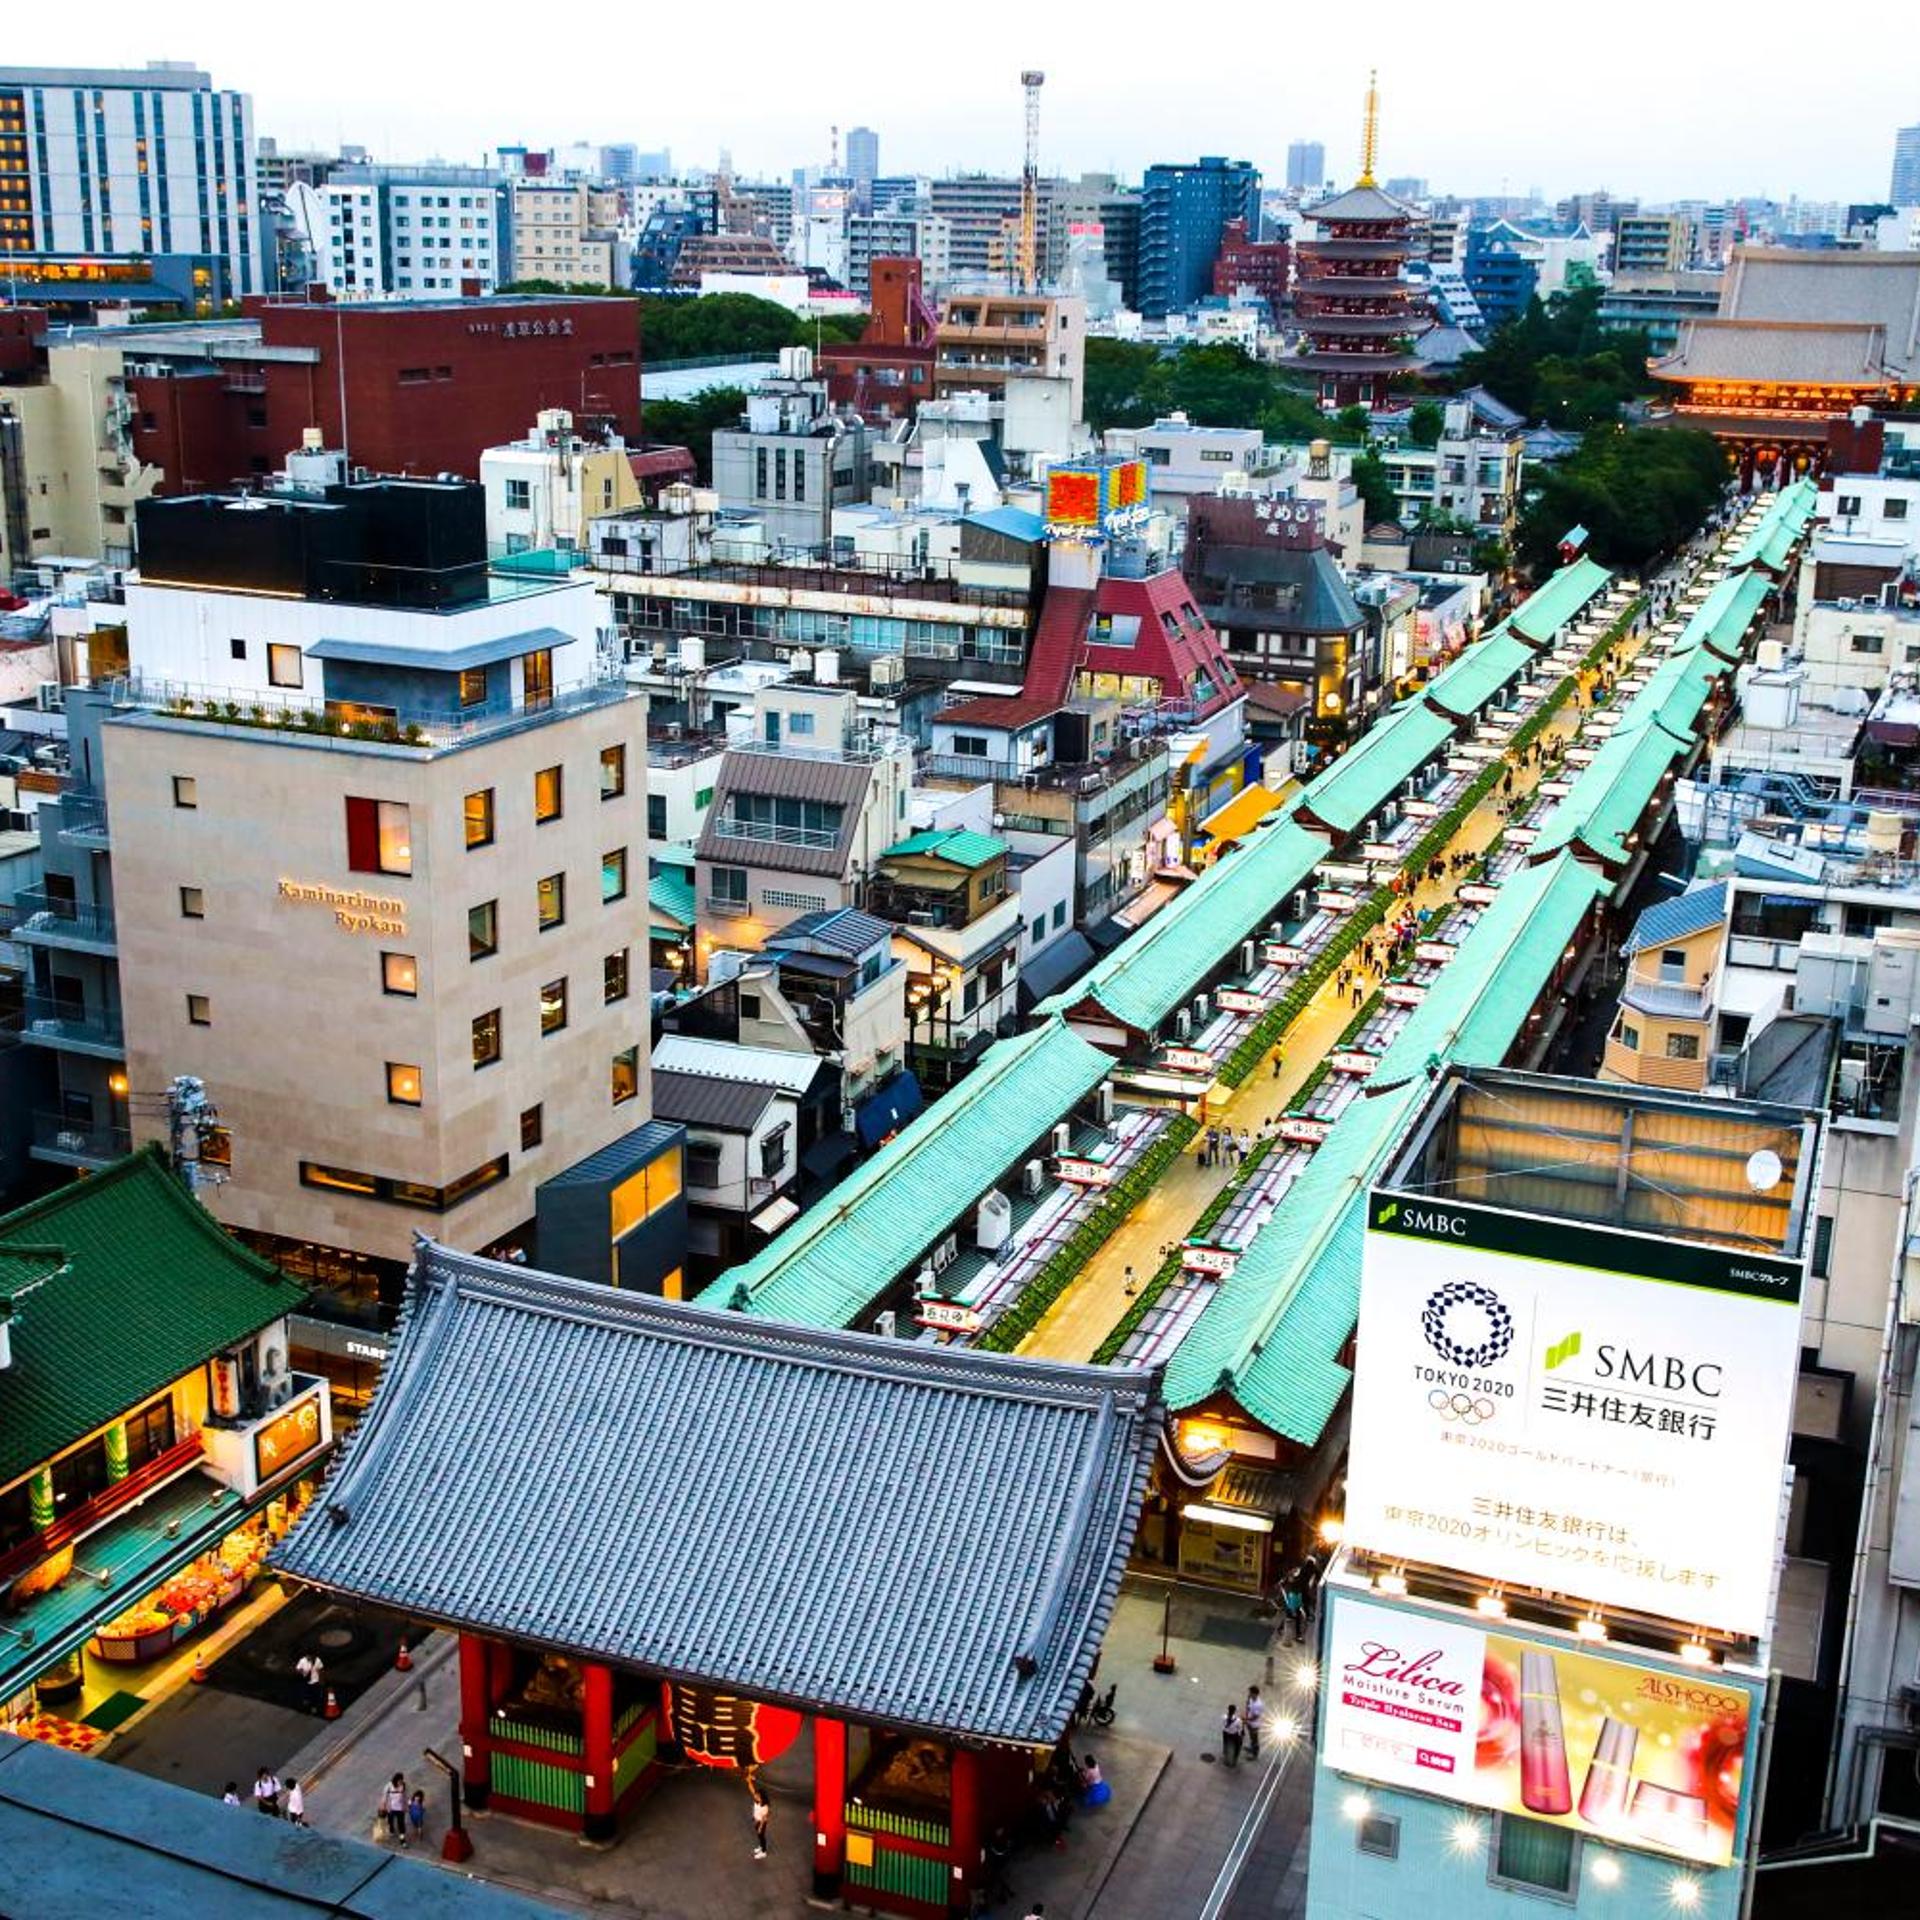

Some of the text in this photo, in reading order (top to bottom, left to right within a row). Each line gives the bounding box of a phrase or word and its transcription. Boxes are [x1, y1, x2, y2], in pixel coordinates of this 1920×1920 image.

[277, 881, 403, 914] Kaminarimon
[1402, 1208, 1467, 1236] SMBC
[1728, 1267, 1790, 1286] SMBCグループ
[1413, 1365, 1514, 1398] TOKYO 2020
[1594, 1344, 1723, 1398] SMBC
[1541, 1386, 1717, 1441] 三井住友銀行
[1383, 1504, 1720, 1590] 東京2020オリンピックを応援します
[1344, 1641, 1465, 1697] Lilica
[1342, 1674, 1465, 1714] Moisture Serum
